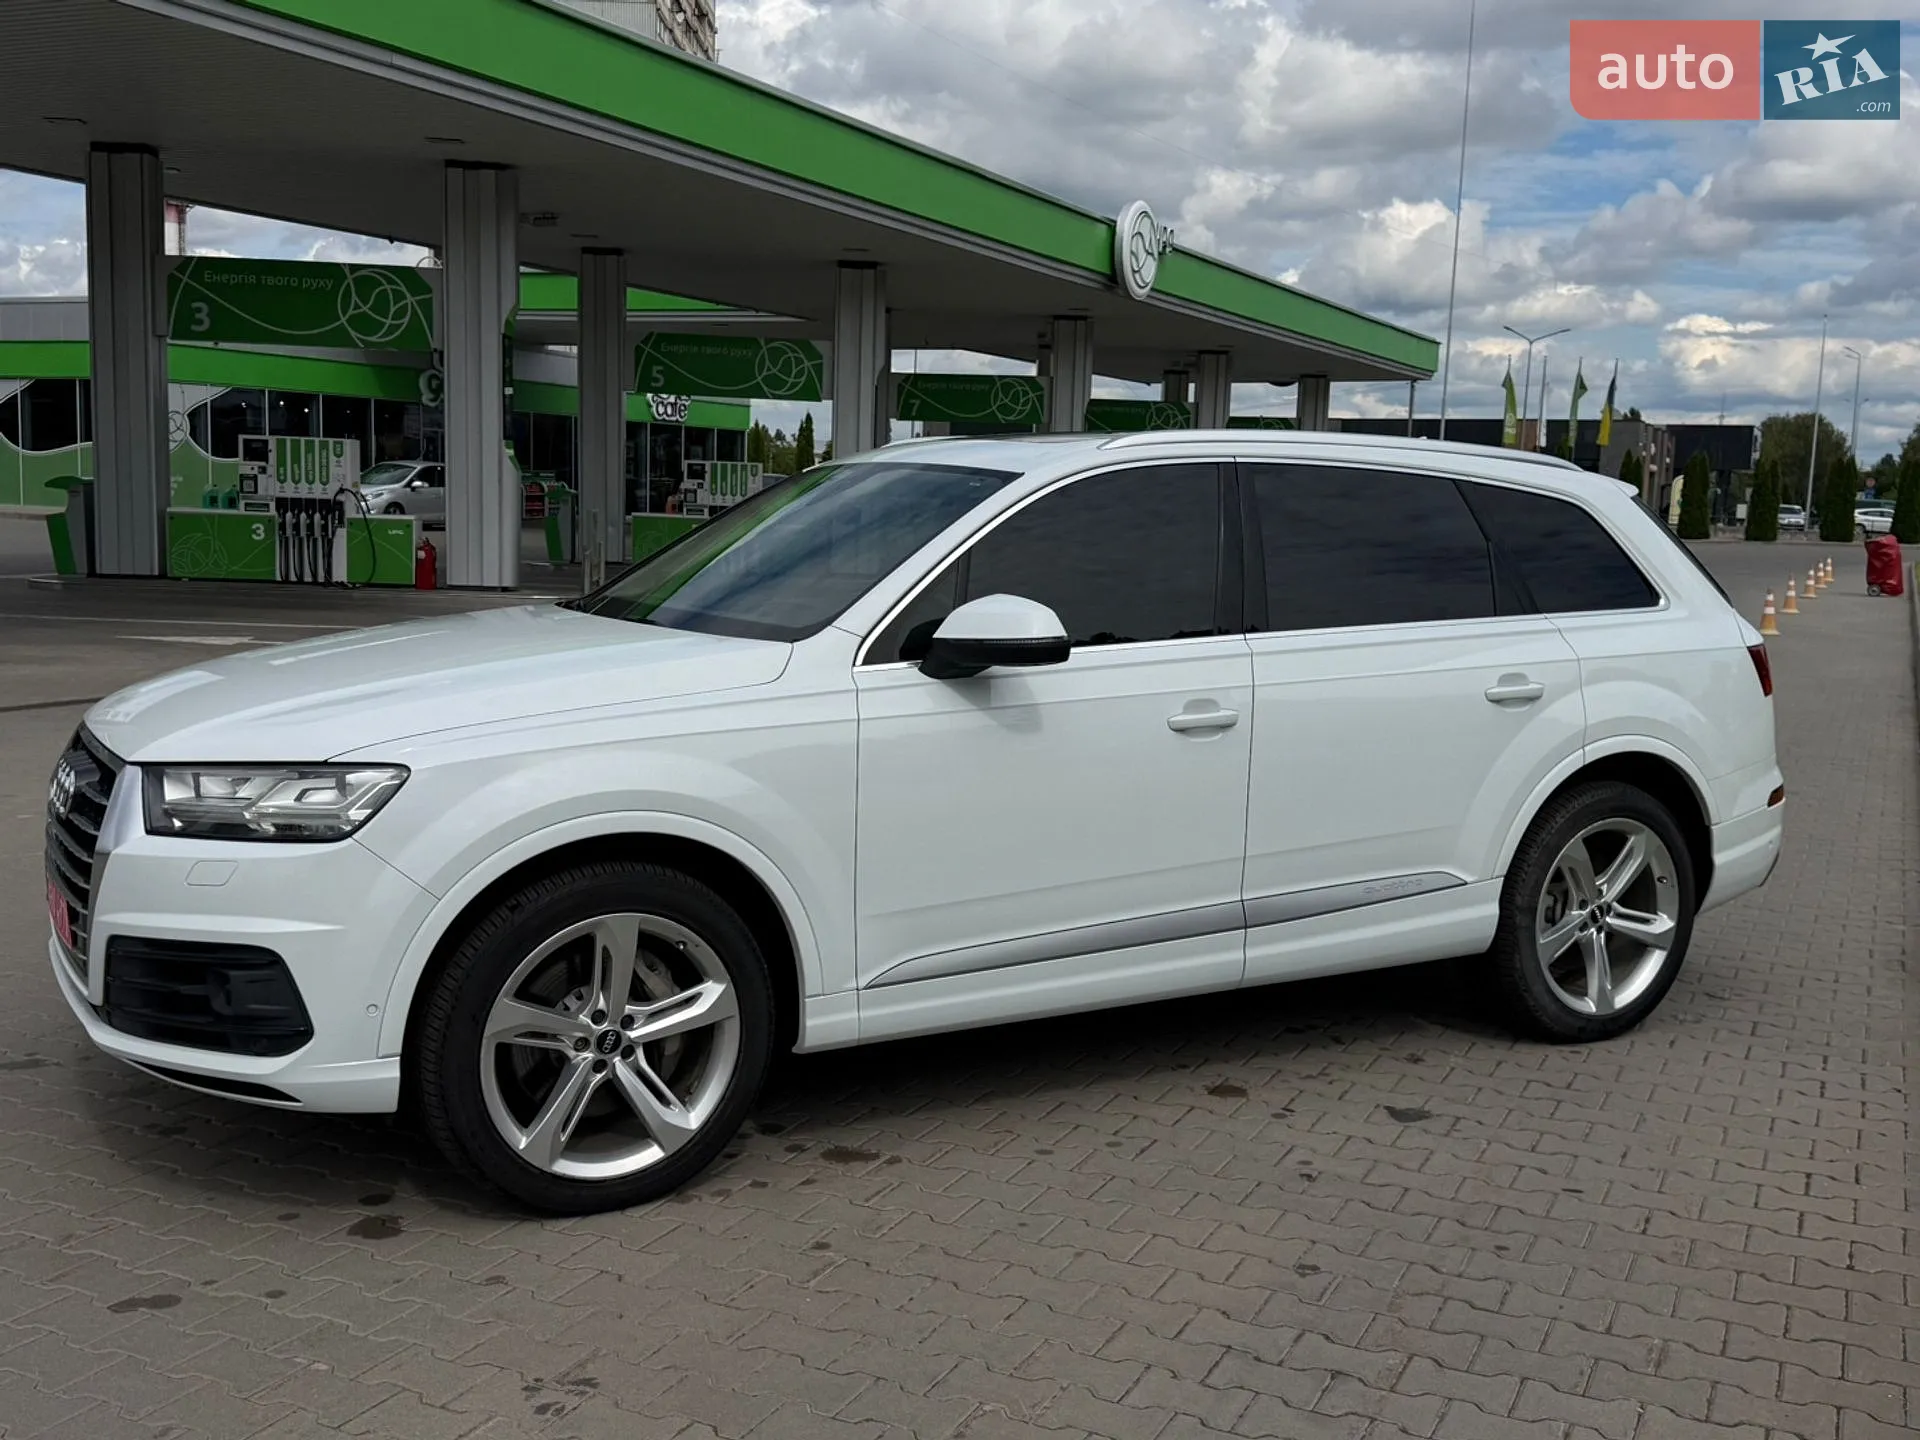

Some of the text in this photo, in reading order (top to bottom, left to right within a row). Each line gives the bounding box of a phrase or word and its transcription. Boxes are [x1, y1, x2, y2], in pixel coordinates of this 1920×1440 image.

[203, 269, 335, 291] Енергія твого руху
[190, 301, 211, 332] 3
[651, 365, 665, 388] 5
[909, 399, 920, 417] 7
[251, 523, 265, 541] 3
